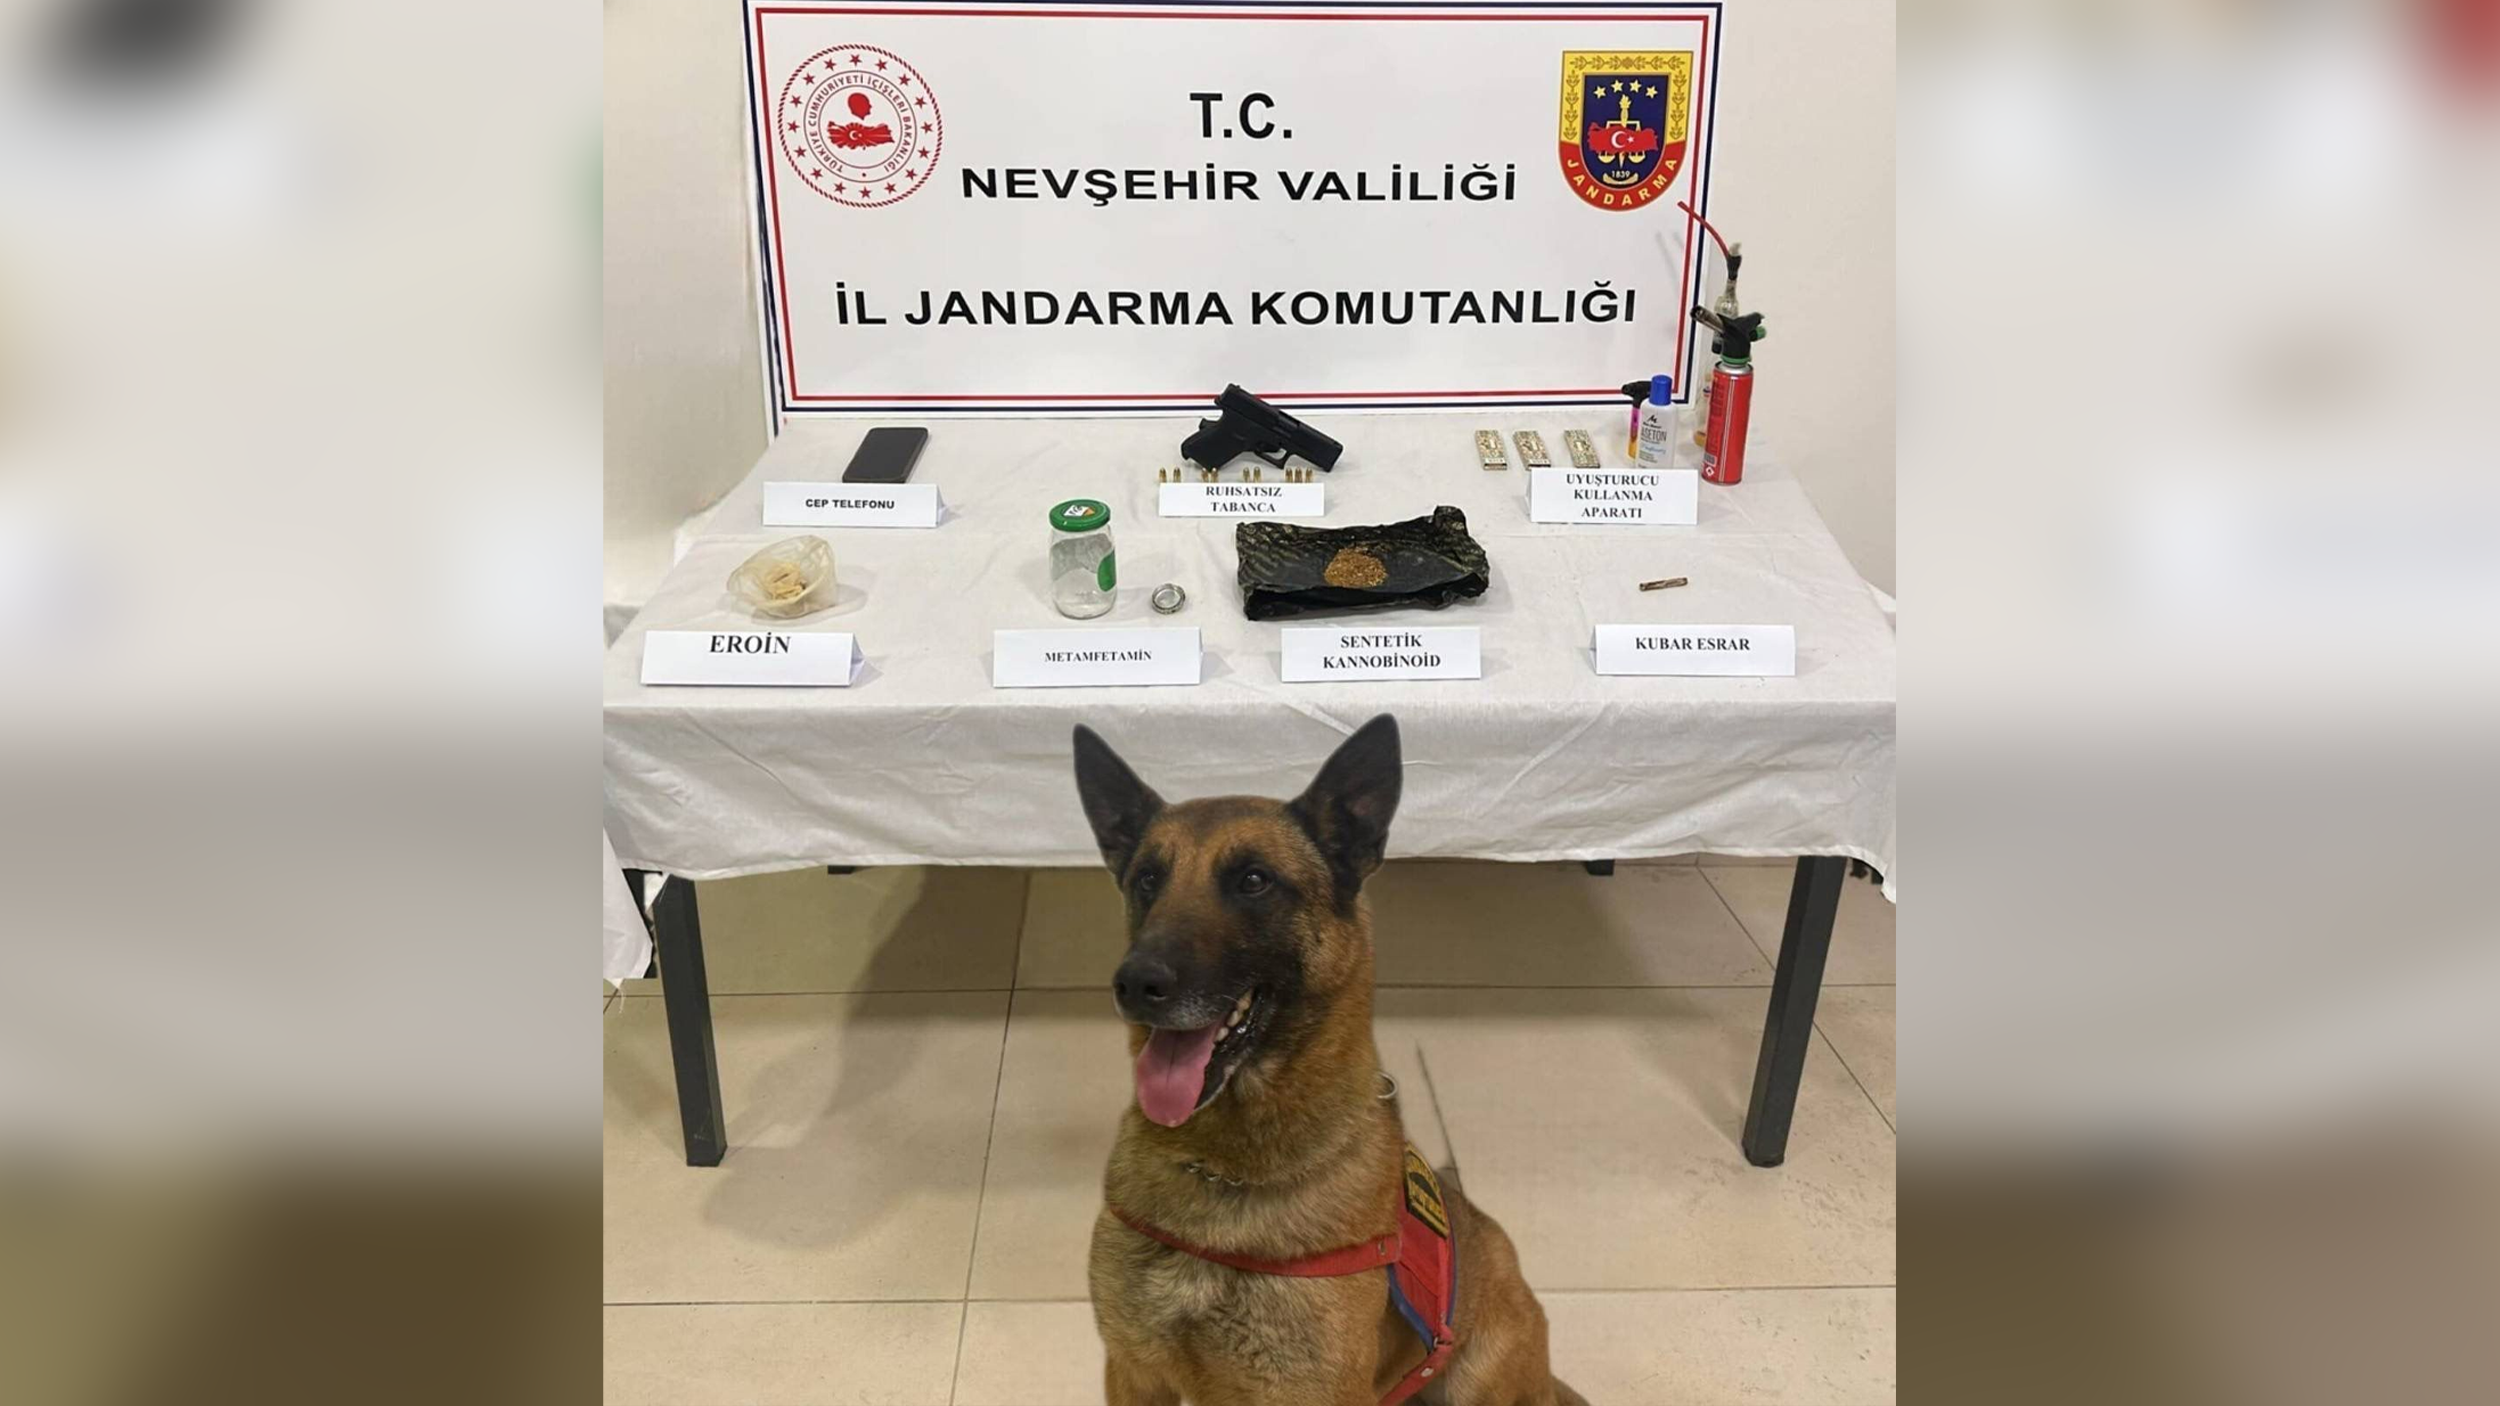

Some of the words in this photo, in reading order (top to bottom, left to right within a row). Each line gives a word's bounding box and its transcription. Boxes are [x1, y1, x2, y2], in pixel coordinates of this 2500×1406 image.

[808, 74, 864, 127] CUMHURİYETİ
[867, 76, 910, 114] İÇİŞLERİ
[1189, 91, 1293, 140] T.C.
[808, 131, 845, 173] TÜRKİYE
[883, 115, 912, 173] BAKANLIĞI
[1566, 158, 1678, 207] JANDARMA
[1611, 170, 1631, 179] 1839
[961, 161, 1261, 208] NEVŞEHİR
[1276, 161, 1517, 203] VALİLİĞİ
[835, 280, 888, 326] İL
[903, 289, 1235, 326] JANDARMA
[1249, 279, 1637, 326] KOMUTANLIĞI
[1565, 473, 1660, 488] UYUŞTURUCU
[1205, 485, 1283, 498] RUHSATSIZ
[1573, 488, 1653, 502] KULLANMA
[804, 497, 829, 510] CEP
[832, 498, 896, 511] TELEFONU
[1210, 501, 1277, 514] TABANCA
[1581, 505, 1643, 519] APARATI
[709, 631, 791, 655] EROİN
[1340, 632, 1423, 649] SENTETİK
[1635, 635, 1693, 651] KUBAR
[1696, 637, 1752, 652] ESRAR
[1044, 649, 1153, 663] METAMFETAMİN
[1322, 651, 1442, 671] KANNOBİNOİD
